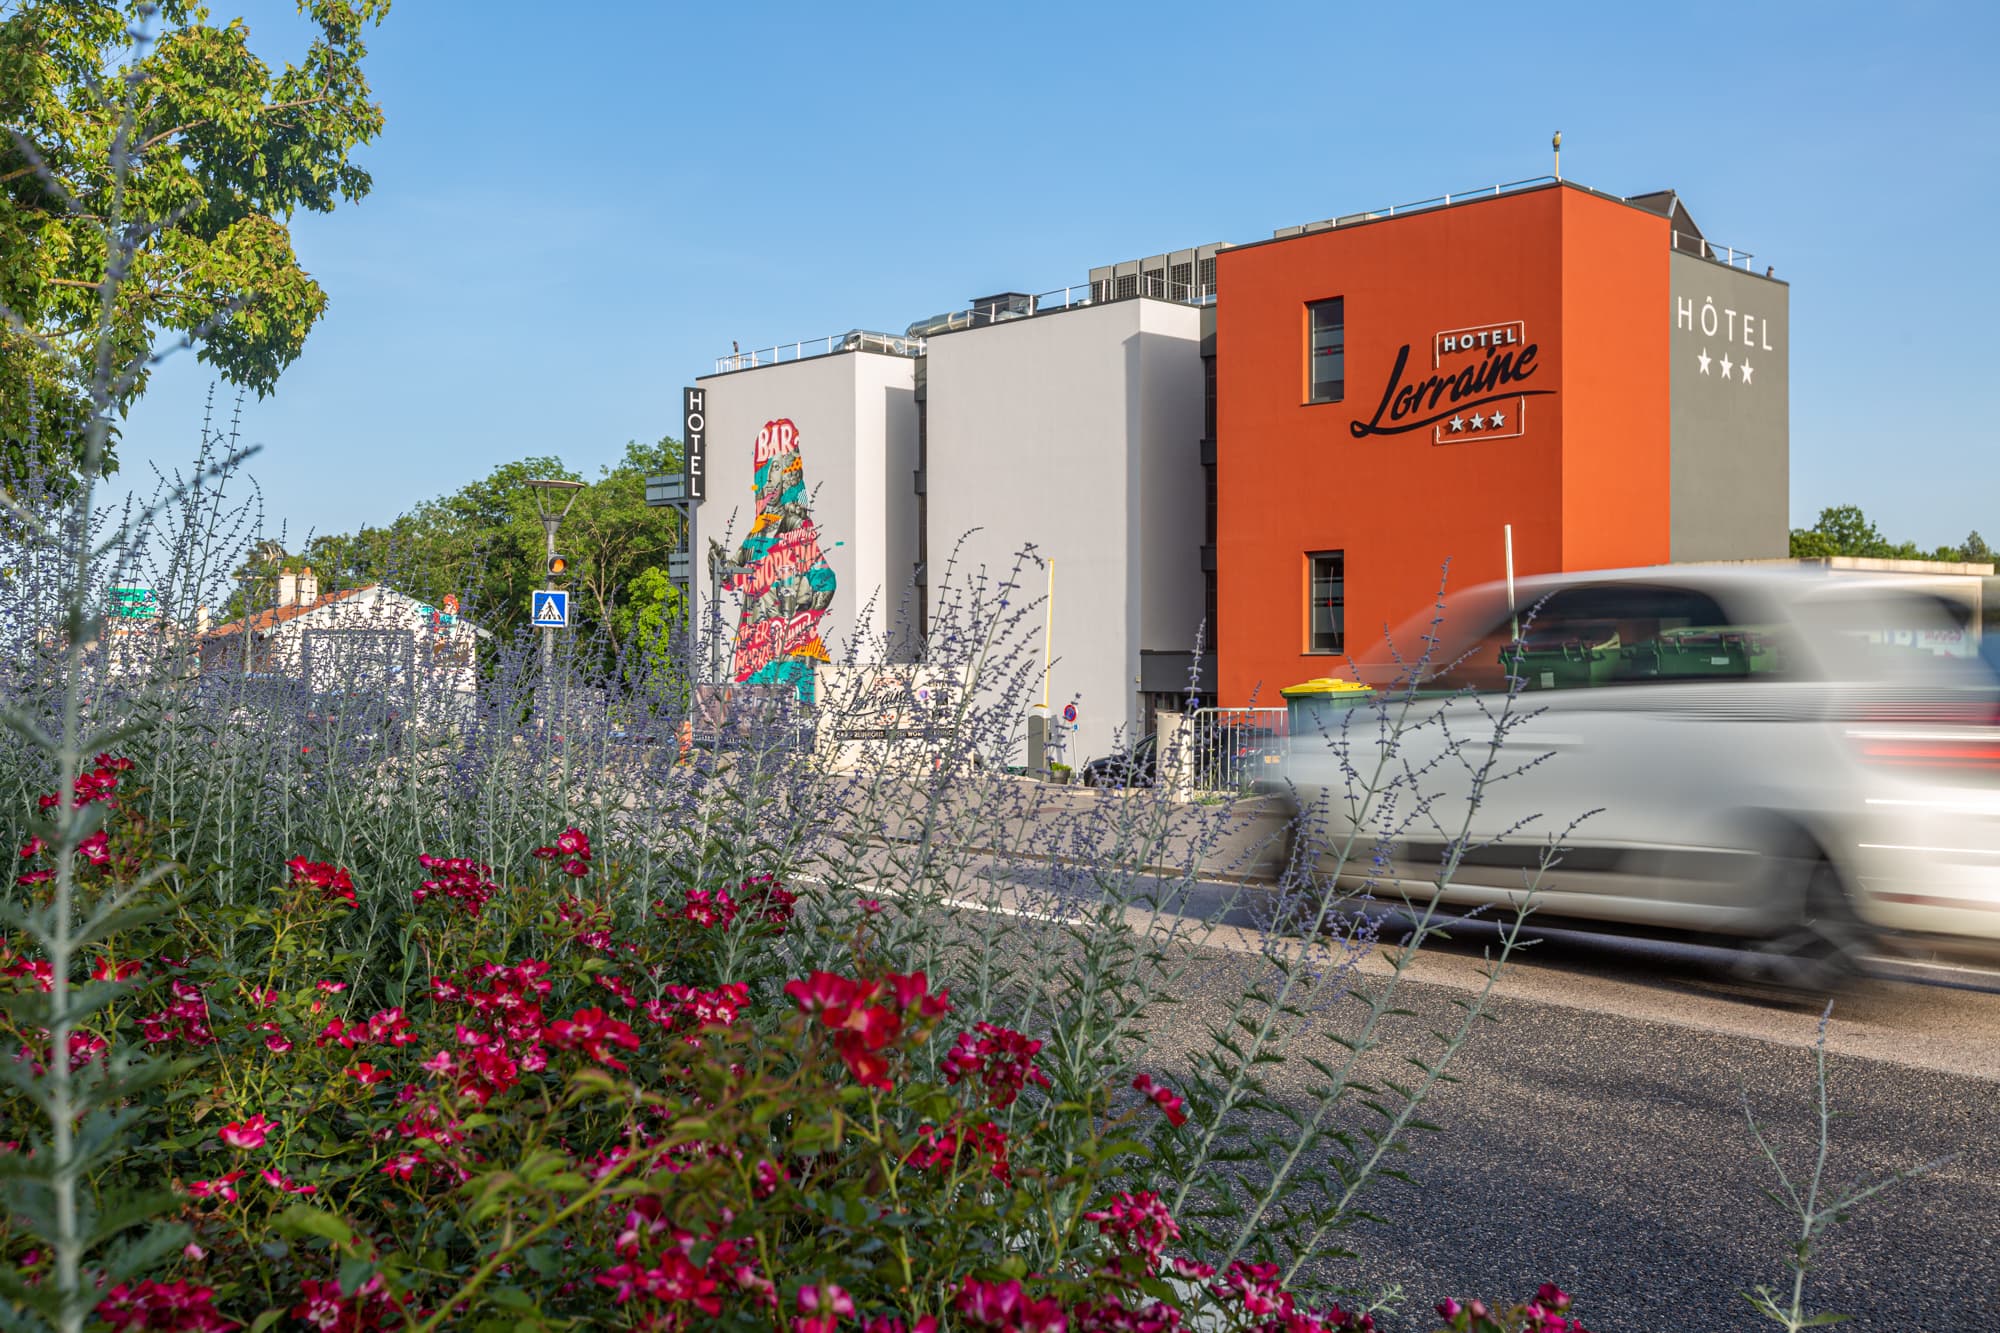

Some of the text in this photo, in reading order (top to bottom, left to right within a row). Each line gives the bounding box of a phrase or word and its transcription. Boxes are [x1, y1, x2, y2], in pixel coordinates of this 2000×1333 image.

[1443, 328, 1517, 352] HOTEL
[1677, 295, 1773, 351] HÔTEL
[1350, 343, 1557, 439] Lorraine
[687, 390, 705, 497] HOTEL
